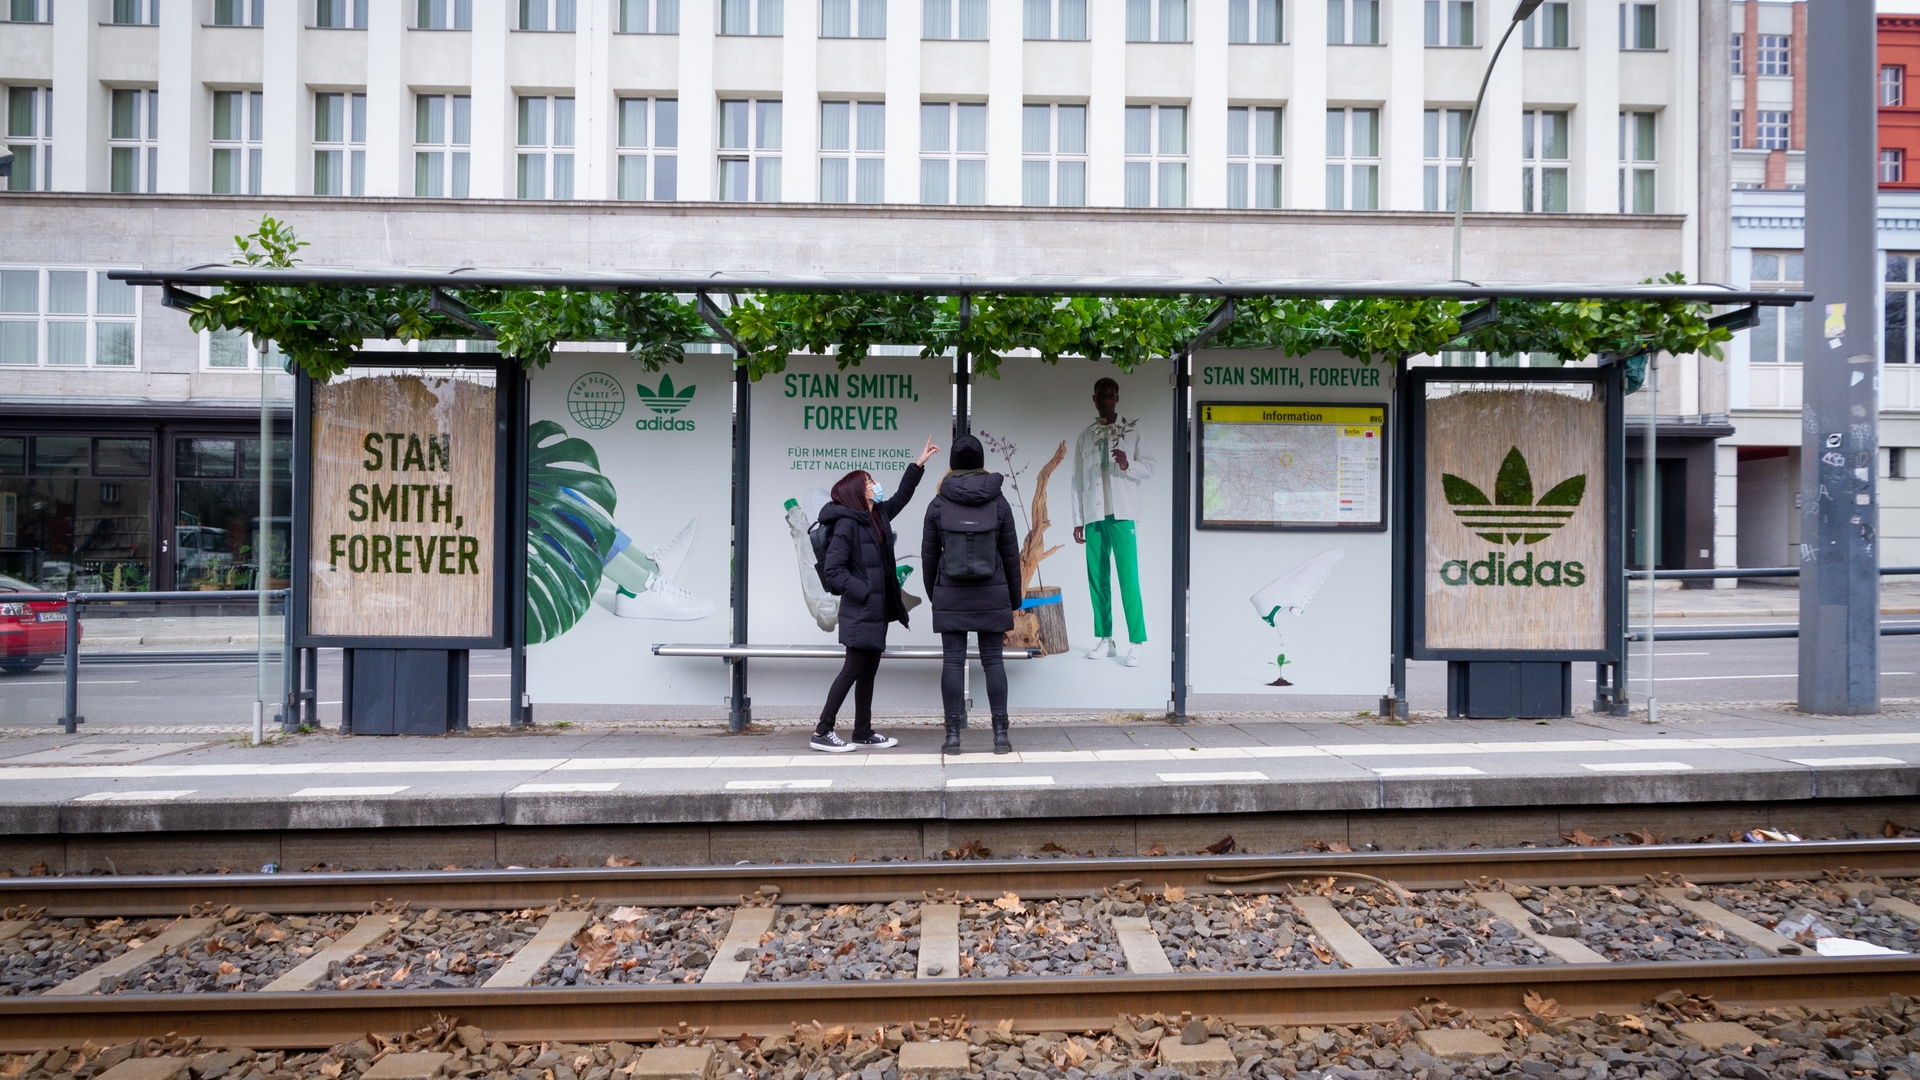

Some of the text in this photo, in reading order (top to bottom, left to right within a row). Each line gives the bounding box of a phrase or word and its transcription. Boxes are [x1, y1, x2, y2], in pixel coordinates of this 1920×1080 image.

[573, 376, 619, 397] END PLASTIC
[784, 373, 919, 404] STAN SMITH,
[1203, 366, 1381, 389] STAN SMITH, FOREVER
[584, 391, 609, 399] WASTE
[635, 416, 696, 432] adidas
[804, 405, 899, 431] FOREVER
[1262, 411, 1323, 422] Information
[1370, 415, 1383, 423] BVG
[363, 432, 451, 472] STAN
[788, 446, 914, 459] FÜR IMMER EINE IKONE.
[790, 460, 906, 471] JETZT NACHHALTIGER
[348, 484, 464, 530] SMITH,
[329, 534, 479, 575] FOREVER
[1439, 551, 1586, 588] adidas
